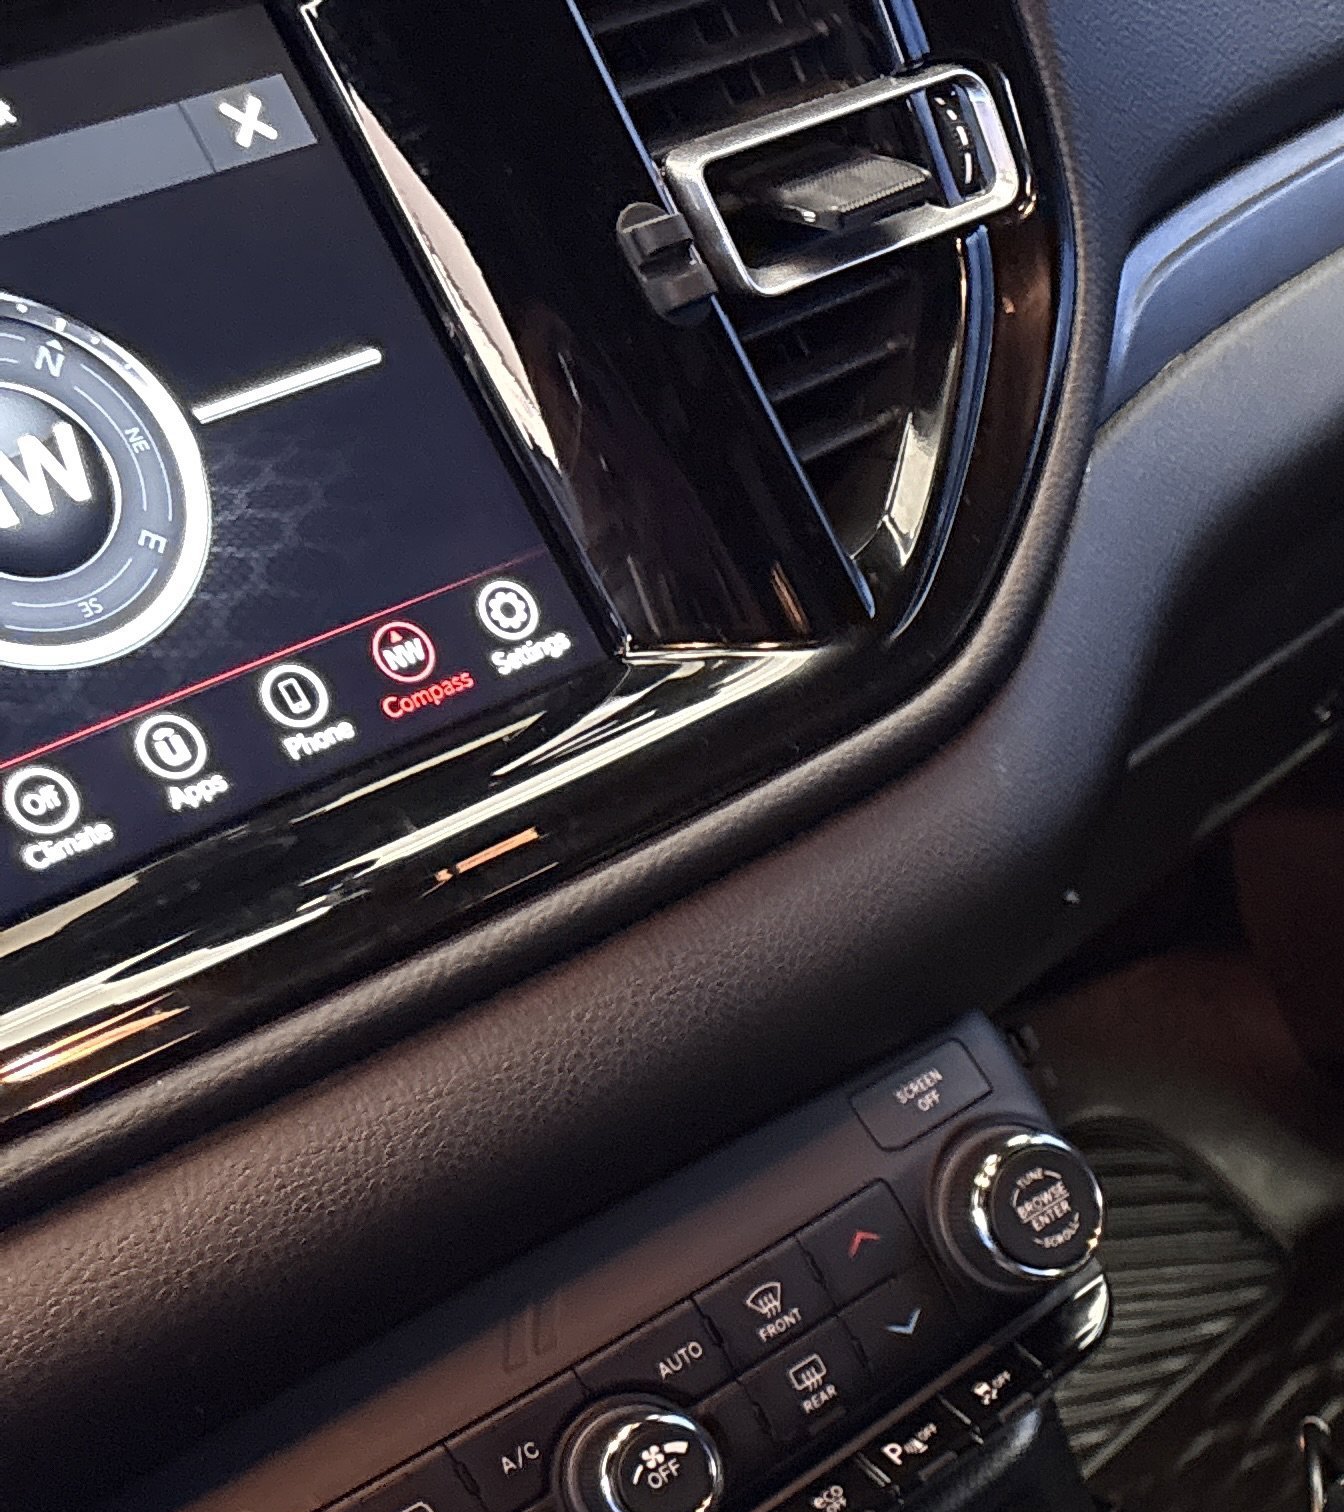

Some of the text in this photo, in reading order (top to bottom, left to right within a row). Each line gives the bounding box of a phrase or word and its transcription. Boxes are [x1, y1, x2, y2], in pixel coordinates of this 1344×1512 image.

[34, 345, 65, 377] N
[124, 427, 150, 454] NE
[0, 421, 92, 529] W
[138, 529, 167, 554] E
[78, 597, 104, 618] SE
[382, 637, 425, 671] NW
[491, 632, 571, 675] Settings
[382, 672, 474, 719] Compass
[284, 719, 356, 761] Phone
[22, 785, 61, 816] Off
[167, 774, 228, 811] Apps
[23, 823, 114, 869] Climate
[896, 1068, 943, 1104] SCREEN
[917, 1089, 940, 1111] OFF
[1016, 1167, 1045, 1189] TUNE
[1017, 1181, 1070, 1221] BROWSE
[1031, 1200, 1072, 1233] ENTER
[1044, 1221, 1080, 1248] SCROLL
[758, 1307, 802, 1342] FRONT
[658, 1341, 703, 1380] AUTO
[803, 1384, 837, 1414] REAR
[501, 1441, 540, 1475] A/C
[881, 1442, 904, 1465] P
[647, 1461, 681, 1489] OFF
